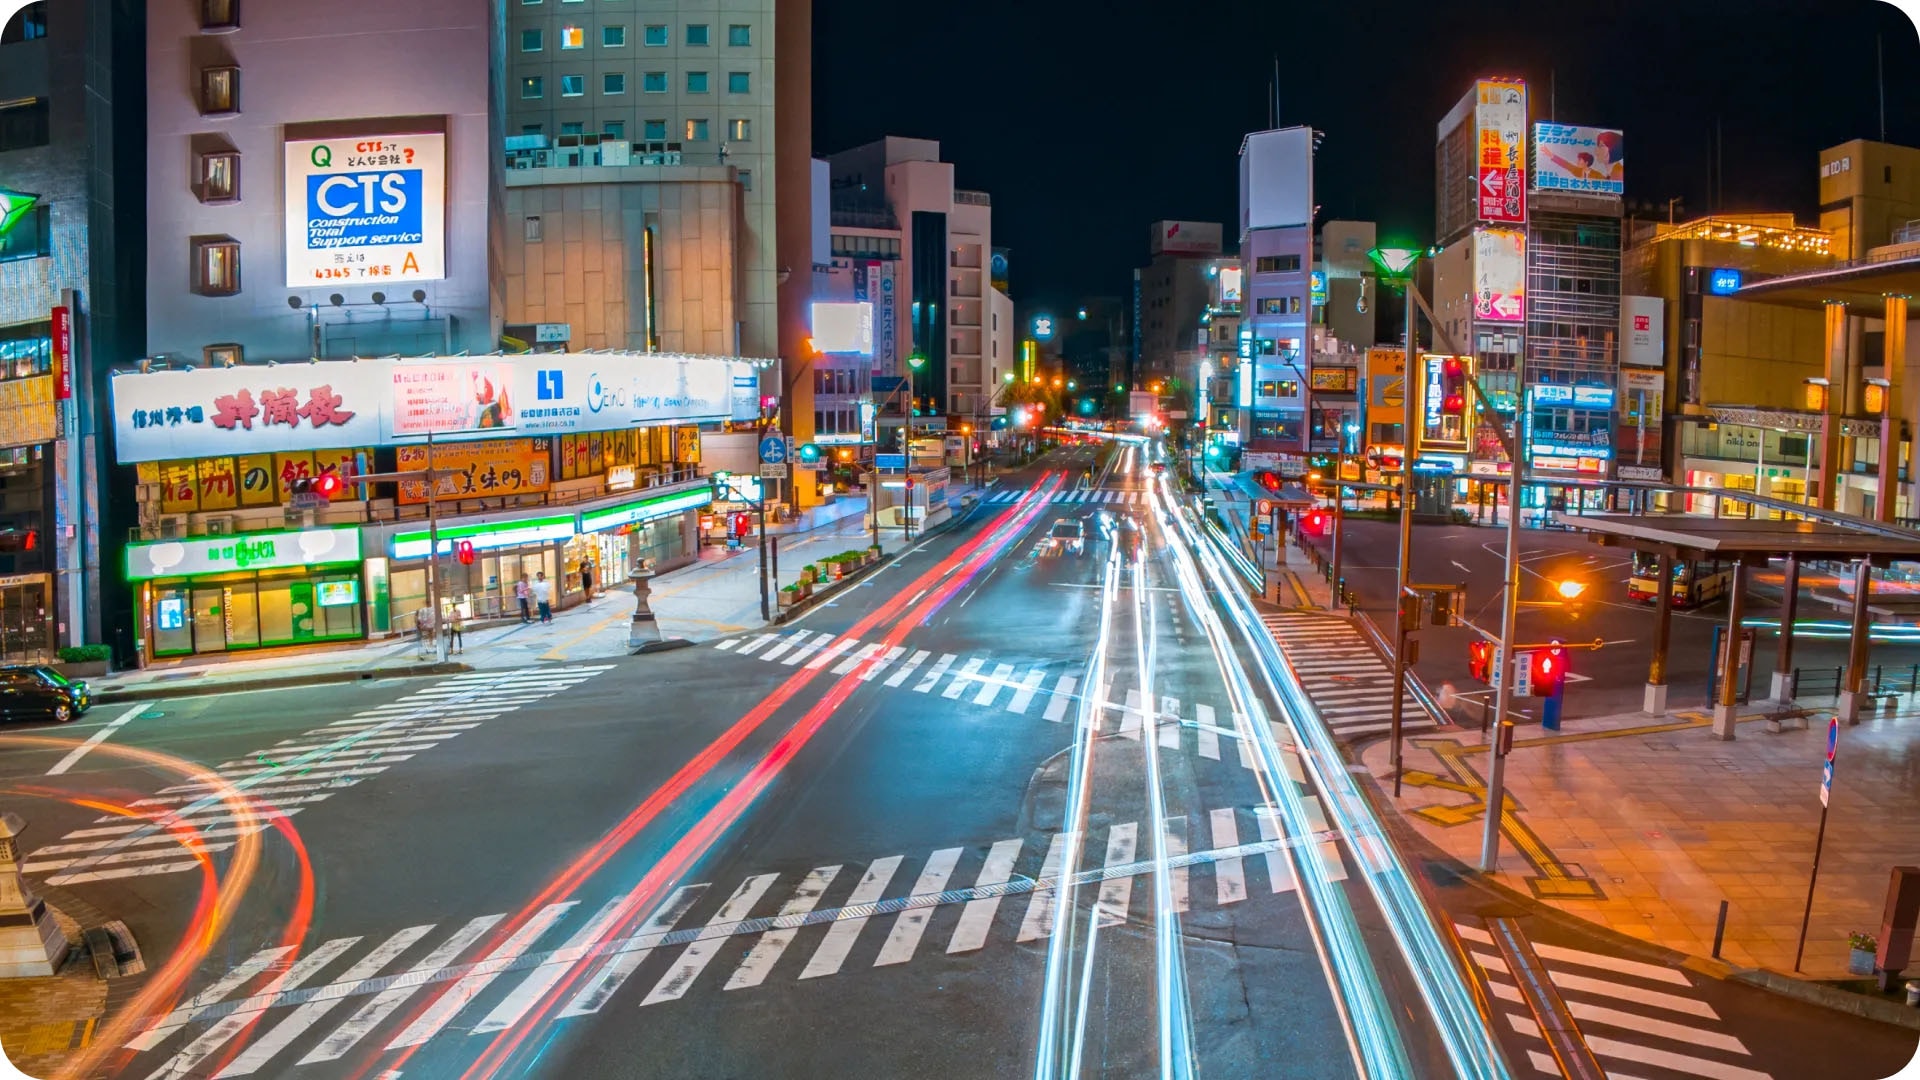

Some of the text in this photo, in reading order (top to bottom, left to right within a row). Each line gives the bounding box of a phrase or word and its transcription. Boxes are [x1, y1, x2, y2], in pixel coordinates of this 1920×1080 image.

[311, 145, 332, 167] Q
[1538, 175, 1623, 193] 長野日本大学学園
[316, 172, 407, 216] CTS
[308, 214, 399, 228] Construction
[309, 226, 346, 237] Total
[308, 232, 422, 248] Support service
[402, 251, 420, 274] A
[315, 267, 351, 279] 4345
[534, 439, 549, 451] 2F
[1726, 437, 1745, 447] niko
[399, 448, 425, 462] 名物
